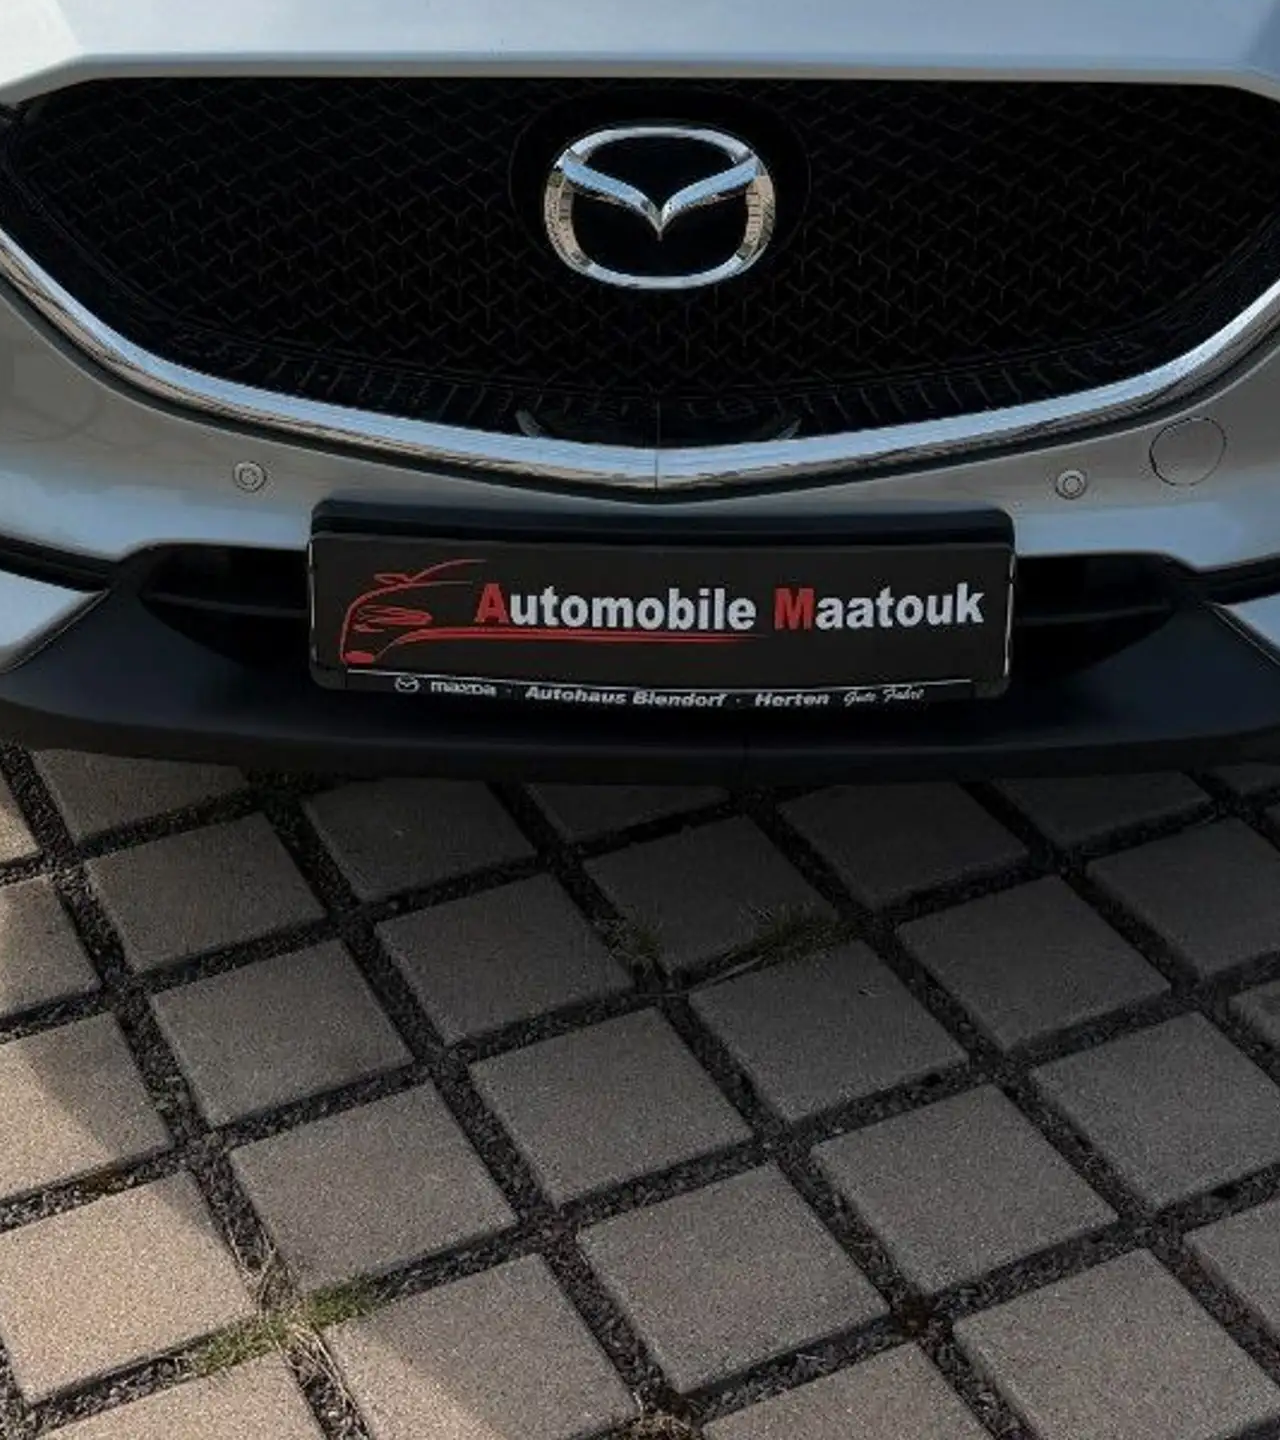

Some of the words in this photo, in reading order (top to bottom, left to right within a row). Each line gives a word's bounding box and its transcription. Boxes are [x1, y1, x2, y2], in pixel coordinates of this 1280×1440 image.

[474, 583, 757, 630] Automobile
[774, 582, 985, 630] Maatouk
[525, 686, 626, 705] Autohaus
[755, 693, 829, 707] Herten
